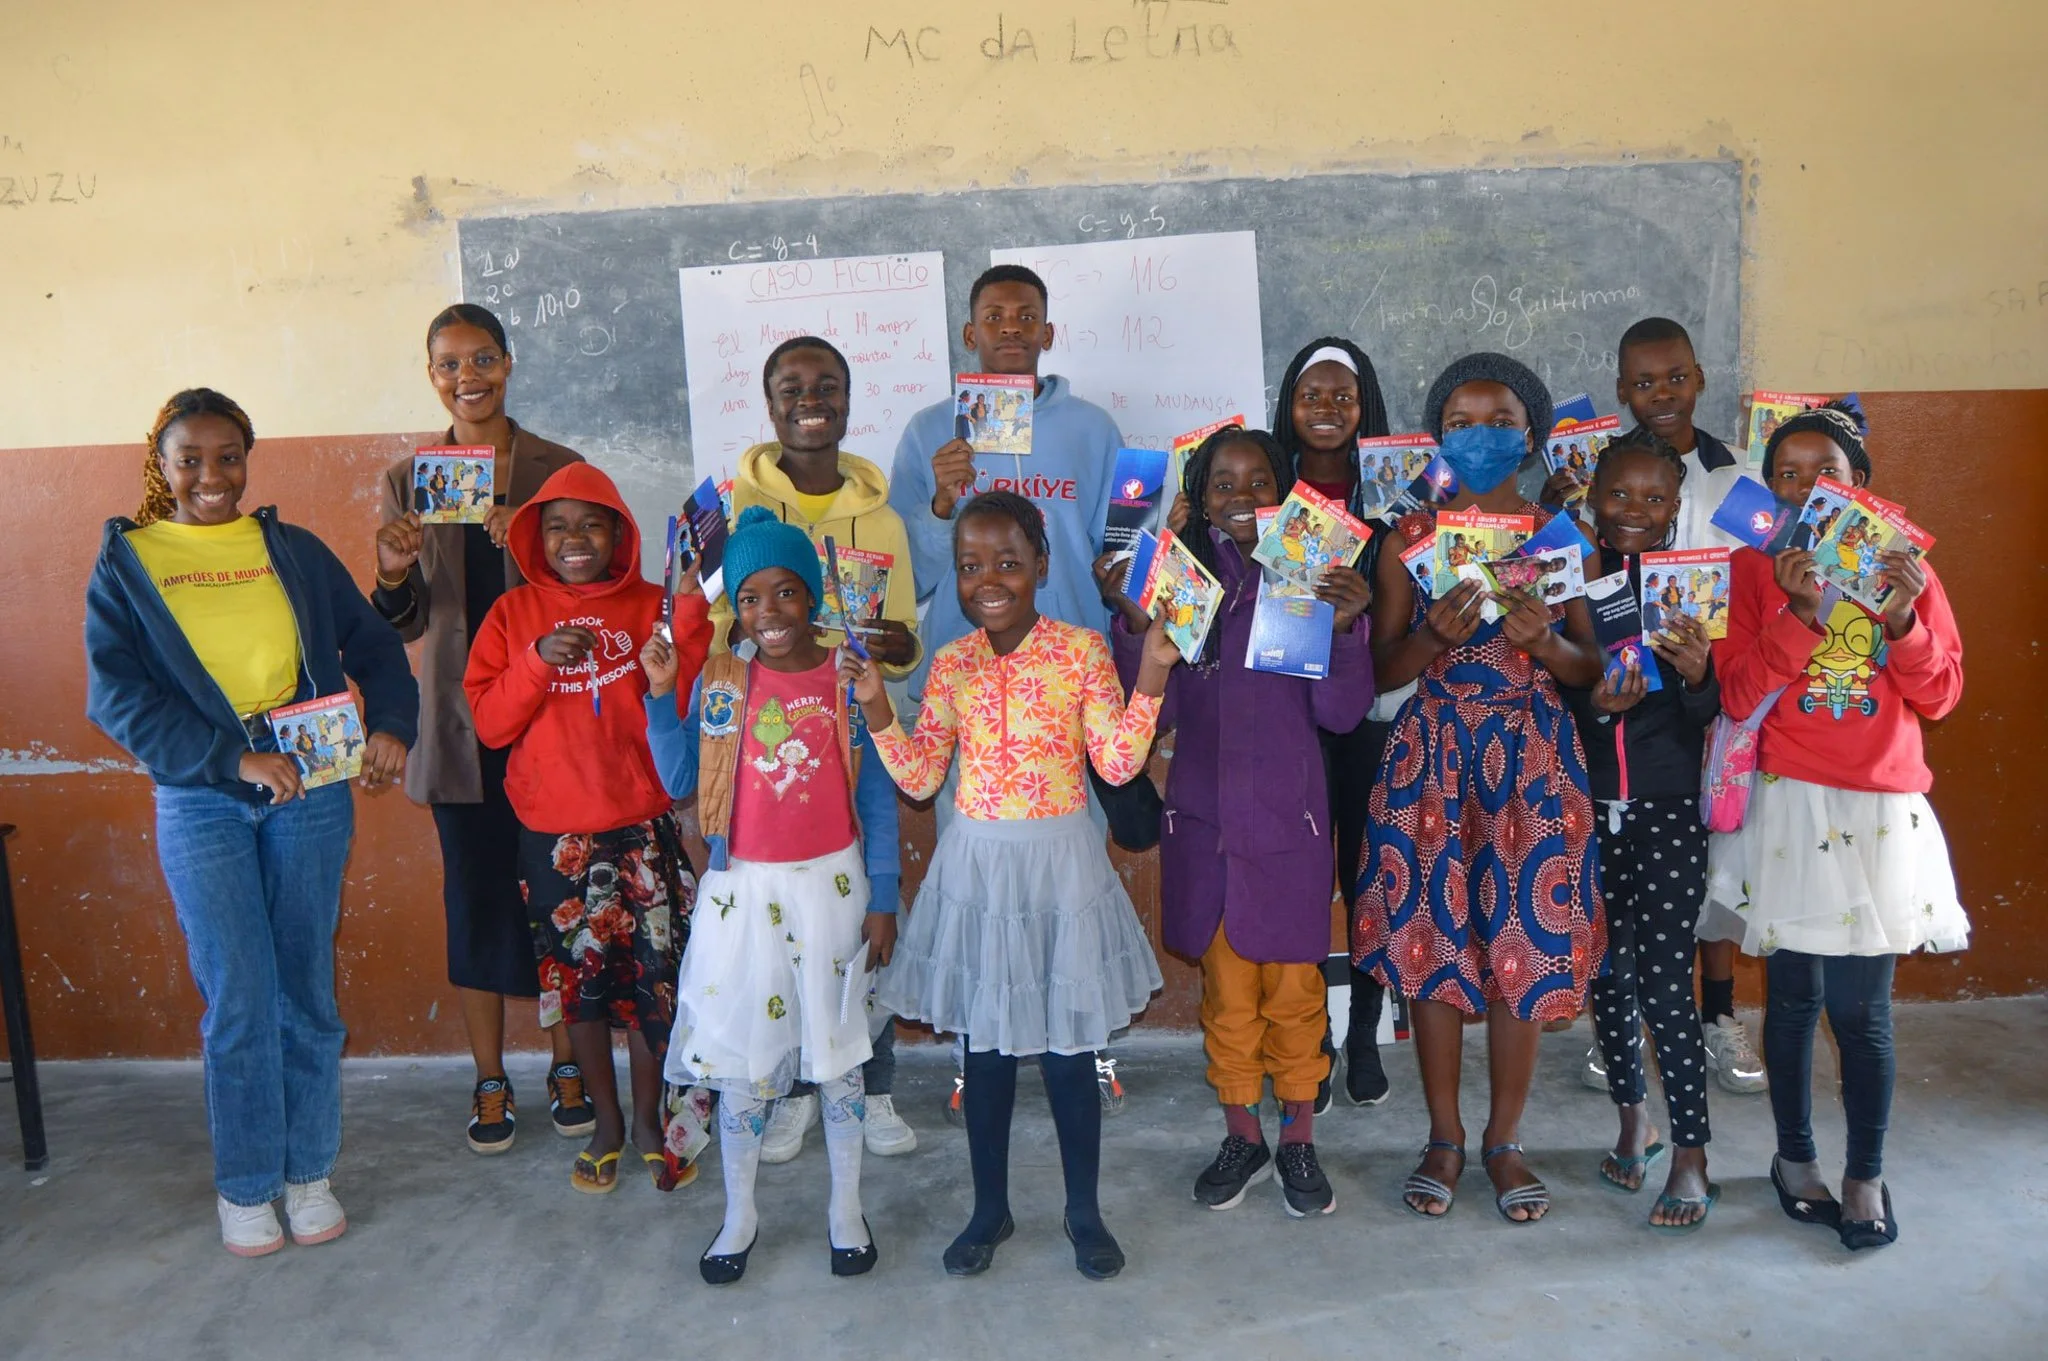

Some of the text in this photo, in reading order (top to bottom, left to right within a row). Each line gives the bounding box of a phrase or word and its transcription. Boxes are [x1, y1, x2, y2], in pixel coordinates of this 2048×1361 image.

[749, 262, 813, 297] CASO
[1130, 255, 1178, 295] 116
[821, 309, 839, 337] de
[1122, 315, 1175, 352] 112
[913, 339, 935, 362] de
[865, 382, 881, 397] 30
[1111, 391, 1237, 416] DE MUDANÇA
[234, 565, 274, 580] MUDAN
[569, 616, 605, 627] TOOK
[558, 661, 600, 676] YEARS
[560, 682, 583, 693] THIS
[786, 696, 823, 711] MERRY
